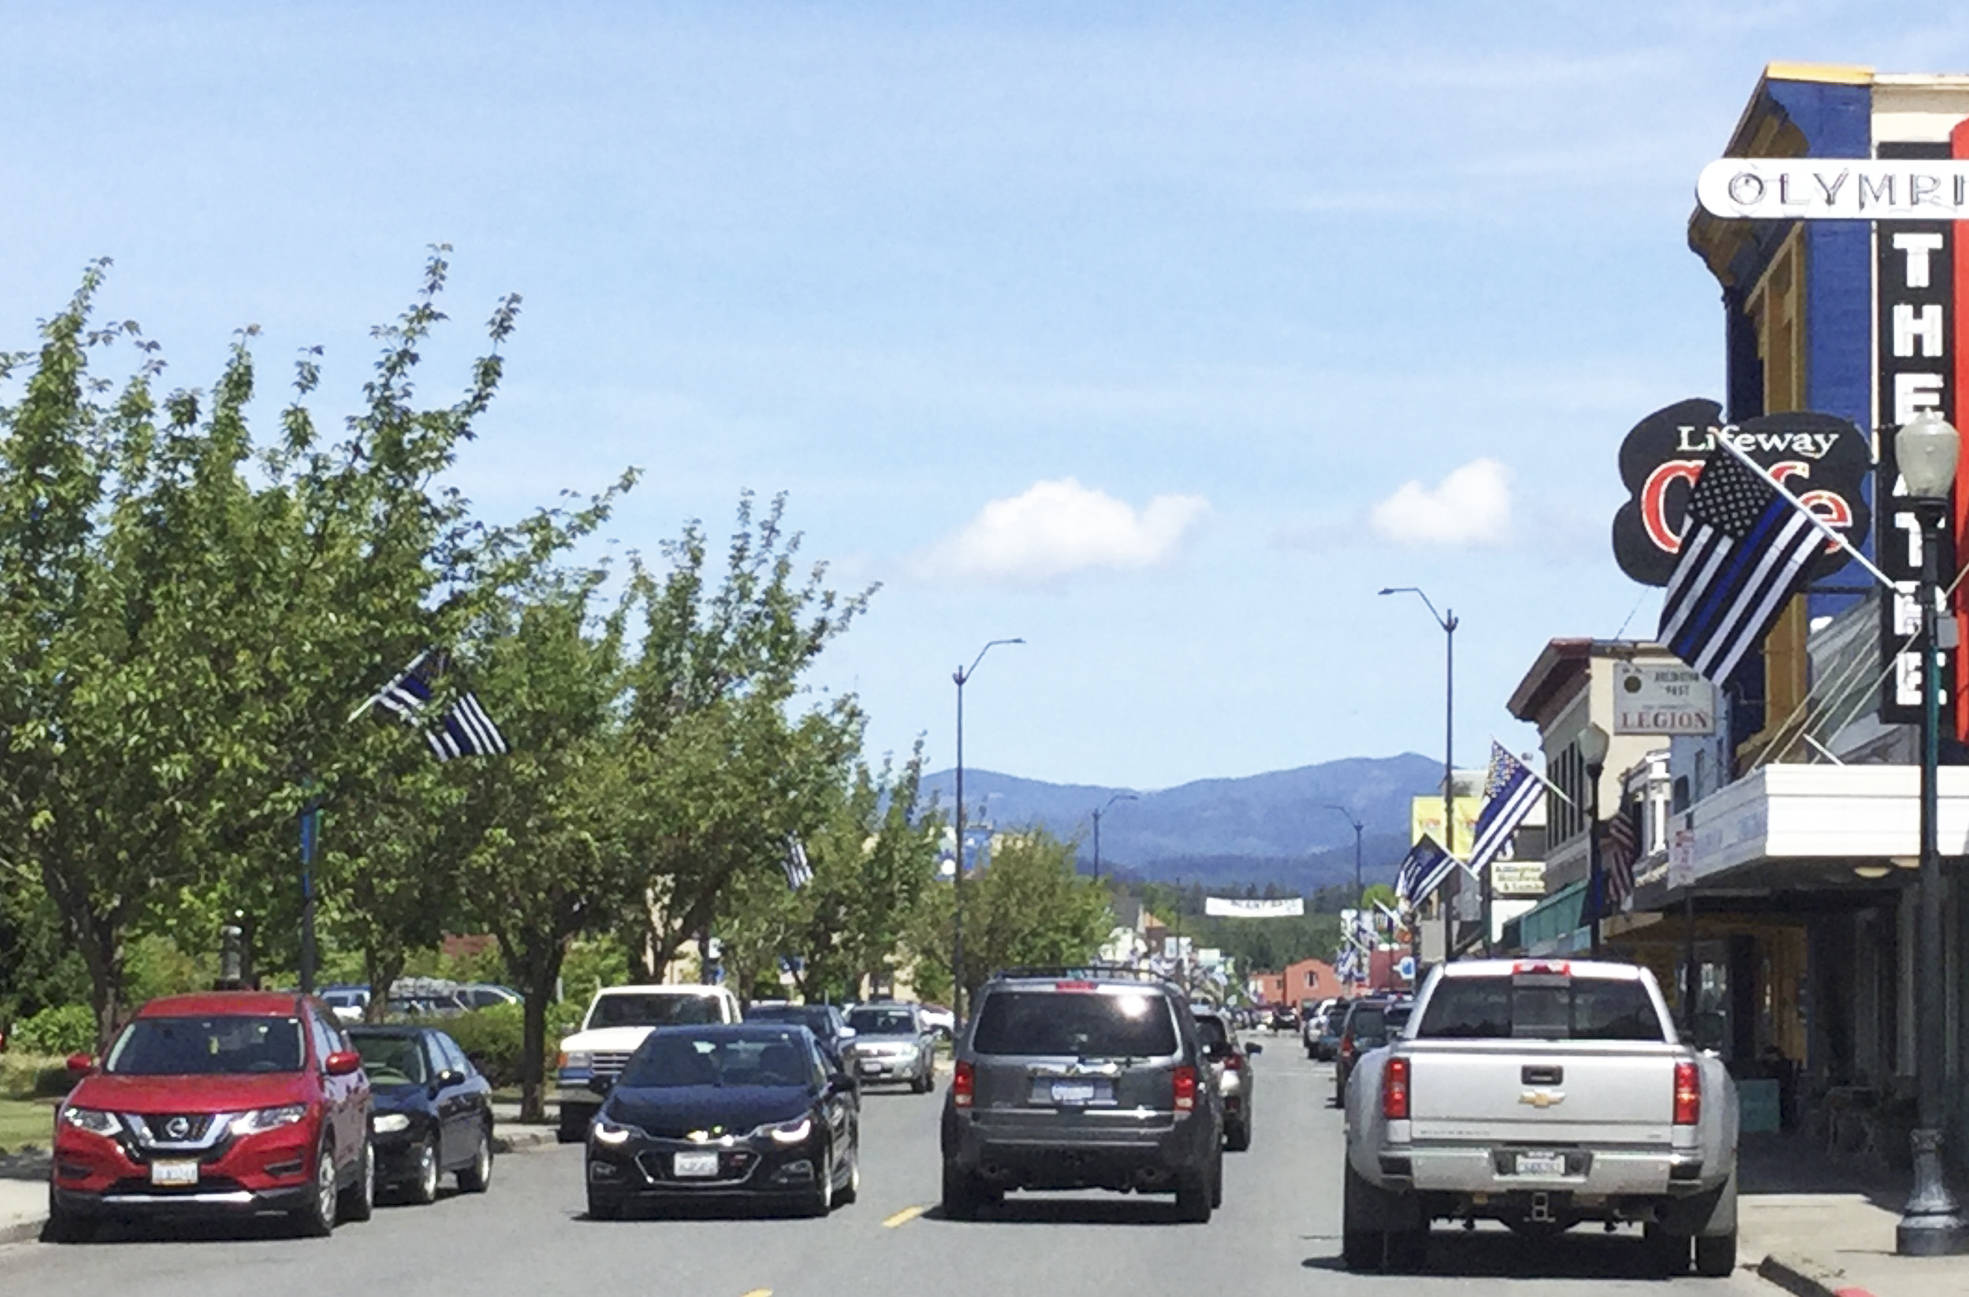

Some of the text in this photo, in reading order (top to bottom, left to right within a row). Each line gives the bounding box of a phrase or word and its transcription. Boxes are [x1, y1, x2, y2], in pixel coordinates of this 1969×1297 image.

[1676, 424, 1840, 460] Lifeway
[1892, 231, 1945, 706] THETRE
[1640, 459, 1853, 555] Ce
[1621, 711, 1711, 729] LEGION
